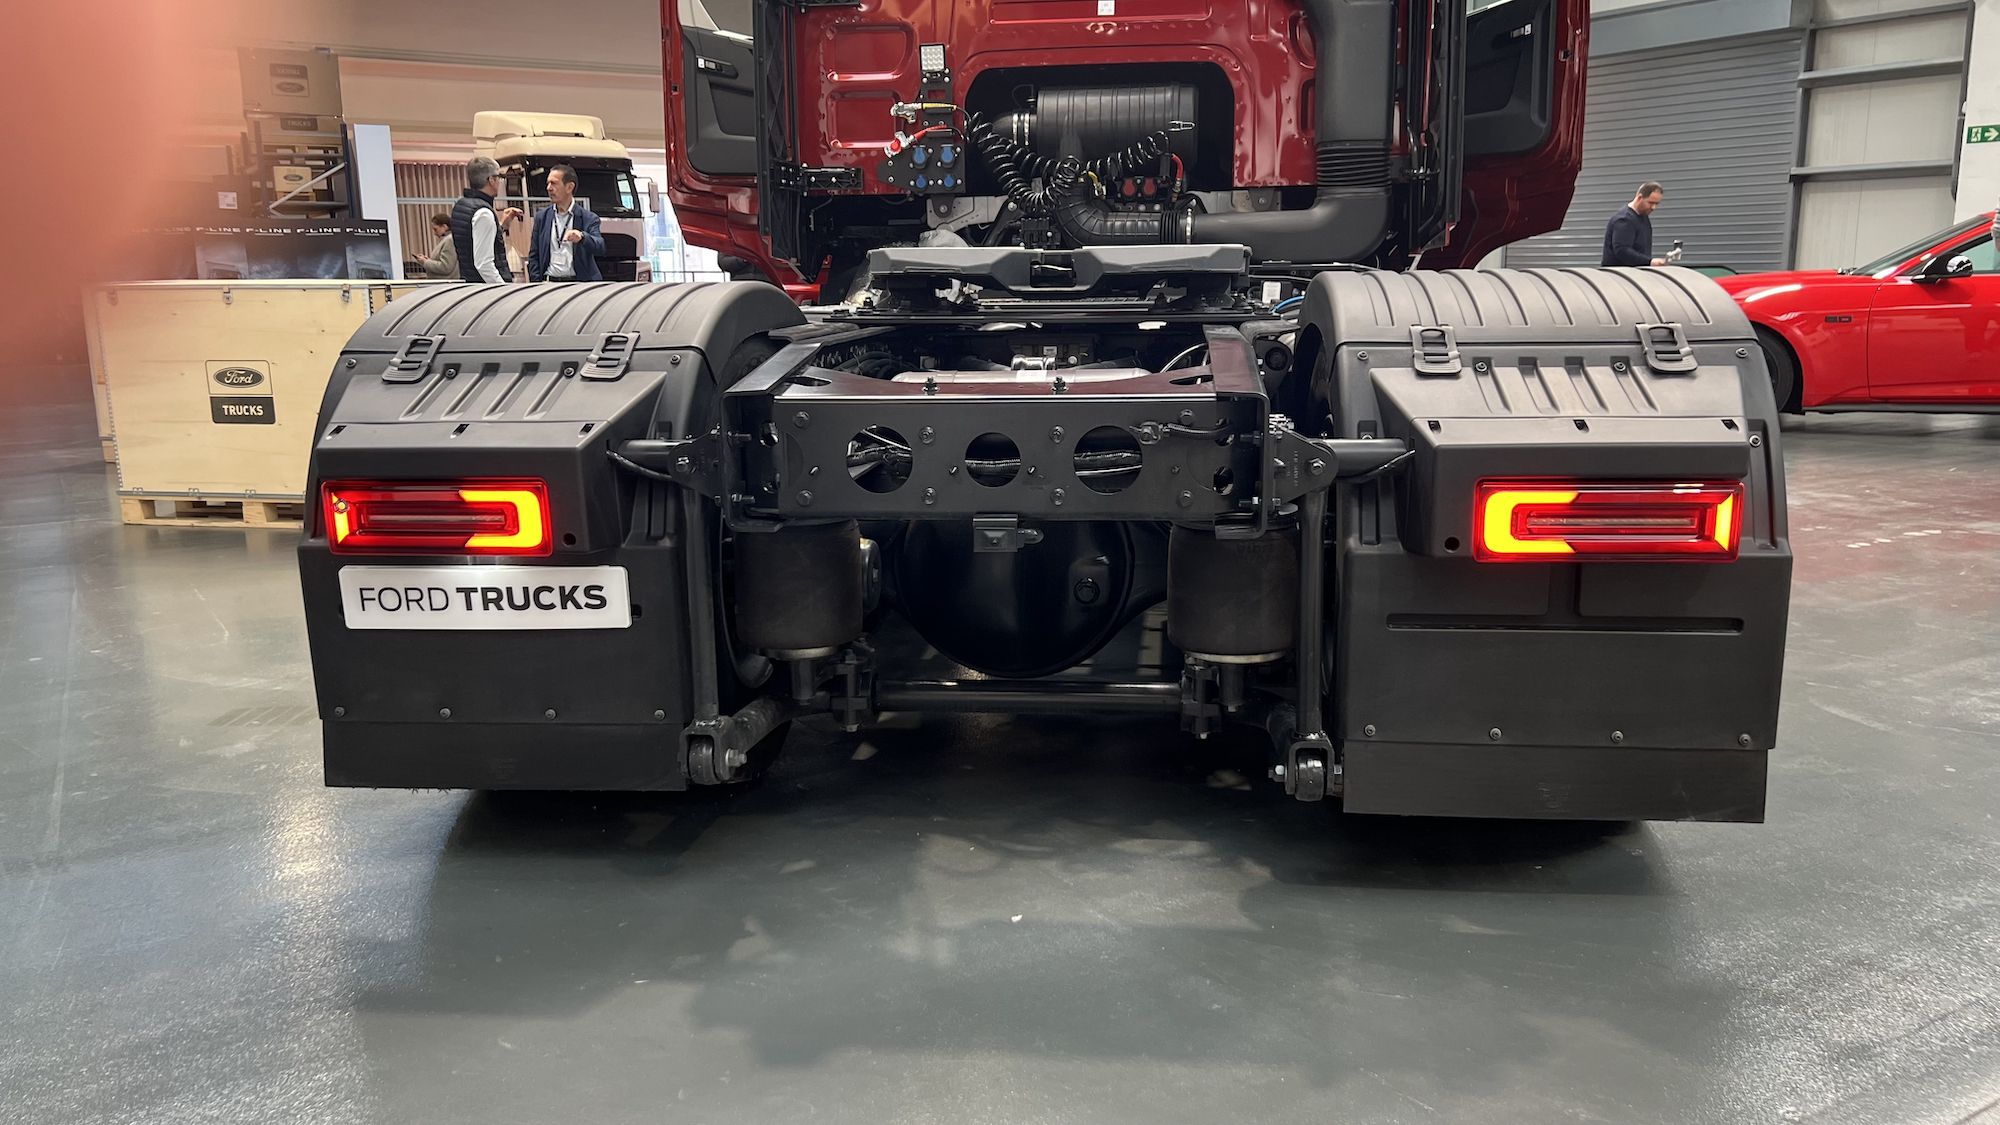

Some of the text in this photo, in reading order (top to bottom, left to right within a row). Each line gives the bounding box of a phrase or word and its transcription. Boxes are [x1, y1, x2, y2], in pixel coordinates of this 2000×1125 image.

[224, 370, 254, 384] Ford
[222, 405, 264, 416] TRUCKS
[359, 585, 607, 611] FORD TRUCKS
